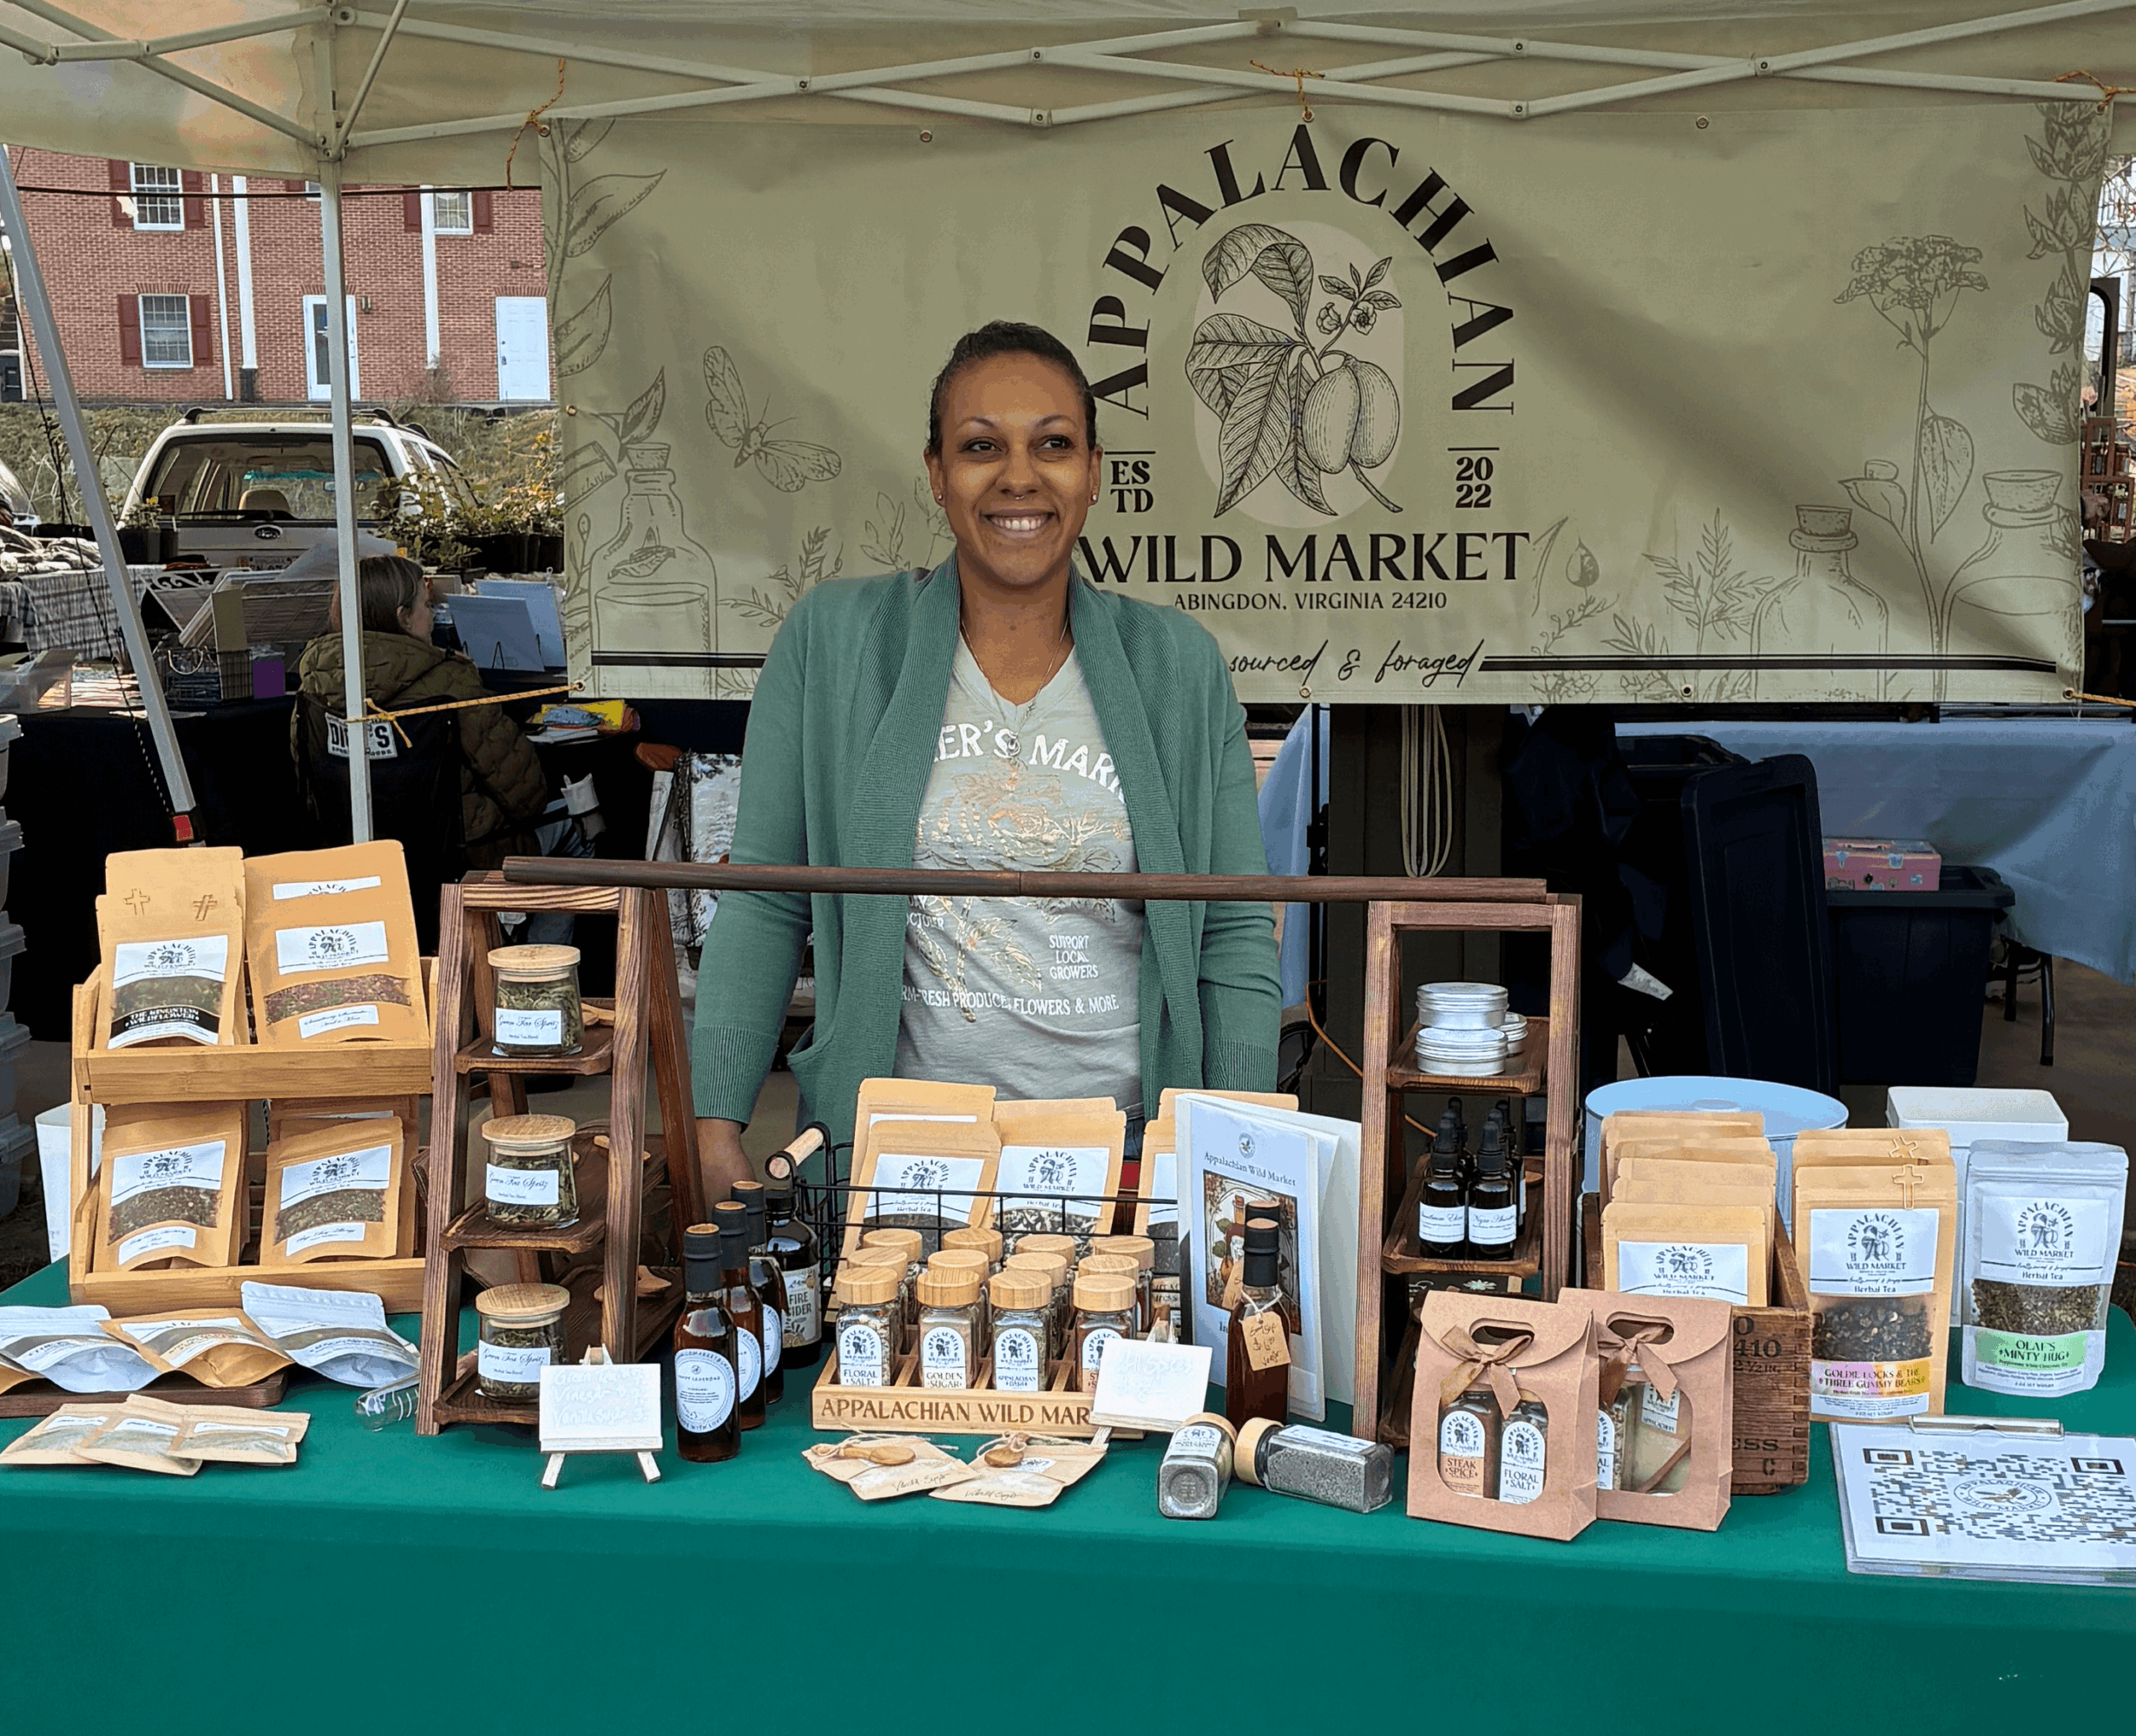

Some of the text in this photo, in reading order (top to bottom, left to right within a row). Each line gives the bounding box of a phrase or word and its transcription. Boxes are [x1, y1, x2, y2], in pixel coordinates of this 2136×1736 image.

[1088, 123, 1515, 420] APPALACHIAN
[1111, 460, 1151, 484] ES
[1456, 457, 1493, 482] 20
[1111, 488, 1154, 514] TD
[1456, 484, 1492, 509] 22
[1079, 532, 1530, 583] WILD MARKET
[1174, 592, 1448, 611] ABINGDON, VIRGINIA 24210
[1229, 639, 1484, 688] sourced & foraged
[329, 722, 390, 748] DI'S
[934, 720, 1021, 762] ER'S
[1055, 950, 1089, 963] LOCAL
[1049, 964, 1098, 980] GROWERS
[1013, 997, 1071, 1016] FLOWERS
[1075, 997, 1085, 1014] &
[1088, 994, 1120, 1014] MORE
[2040, 1249, 2074, 1259] MARKET
[789, 1292, 809, 1305] FIRE
[844, 1369, 877, 1378] FLORAL
[926, 1371, 963, 1380] GOLDEN
[930, 1379, 960, 1388] SUGAR
[821, 1398, 1091, 1425] APPALACHIAN WILD MAR
[1447, 1458, 1476, 1470] STEAK
[1449, 1467, 1475, 1478] SPICE
[1504, 1469, 1539, 1483] FLORAL
[1510, 1480, 1531, 1490] SALT
